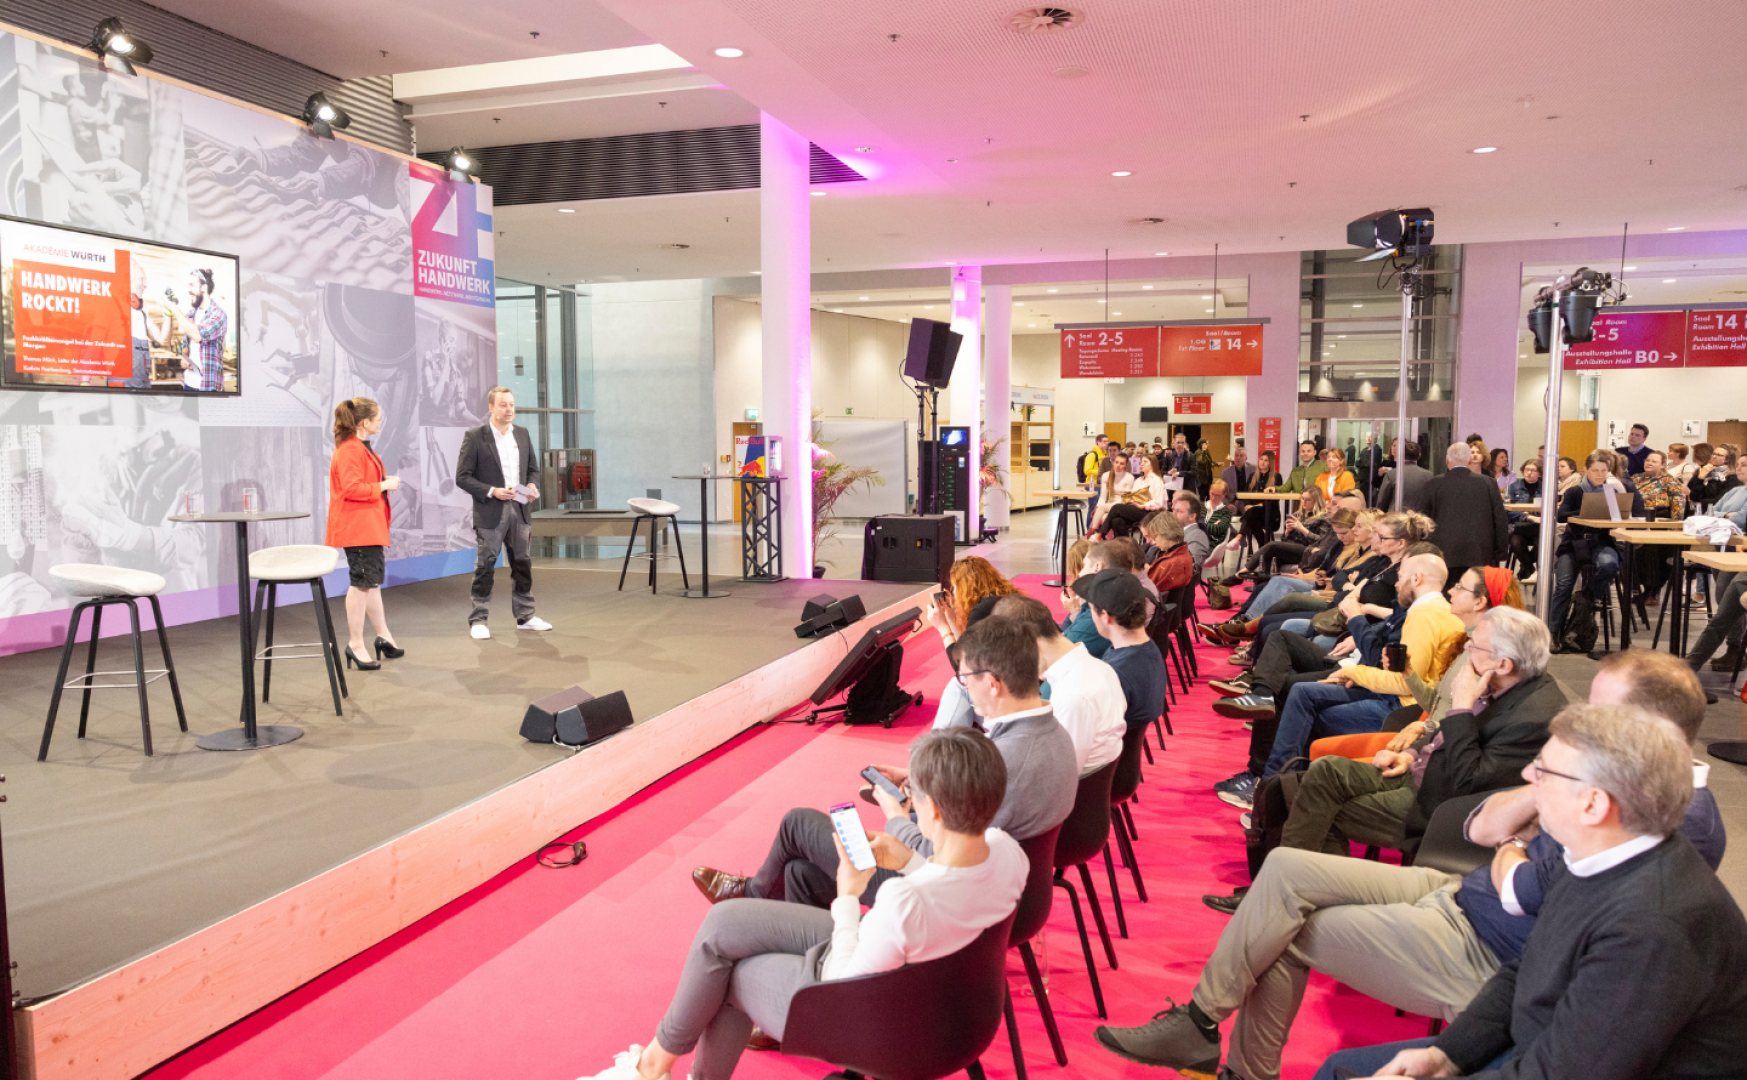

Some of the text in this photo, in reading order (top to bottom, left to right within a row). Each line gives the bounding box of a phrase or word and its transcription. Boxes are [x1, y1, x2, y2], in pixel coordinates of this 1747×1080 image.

[23, 243, 69, 258] AKADEMIE
[418, 249, 478, 276] ZUKUNFT
[21, 270, 112, 297] HANDWERK
[418, 266, 491, 295] HANDWERK
[21, 291, 81, 314] ROCKT!
[1693, 314, 1711, 322] Saal
[1715, 313, 1738, 330] 14
[1079, 331, 1123, 346] Saal 2-5
[1226, 338, 1242, 351] 14
[1565, 349, 1632, 358] Ausstellungshalle
[1635, 350, 1659, 364] B0
[735, 437, 764, 445] Red Bull
